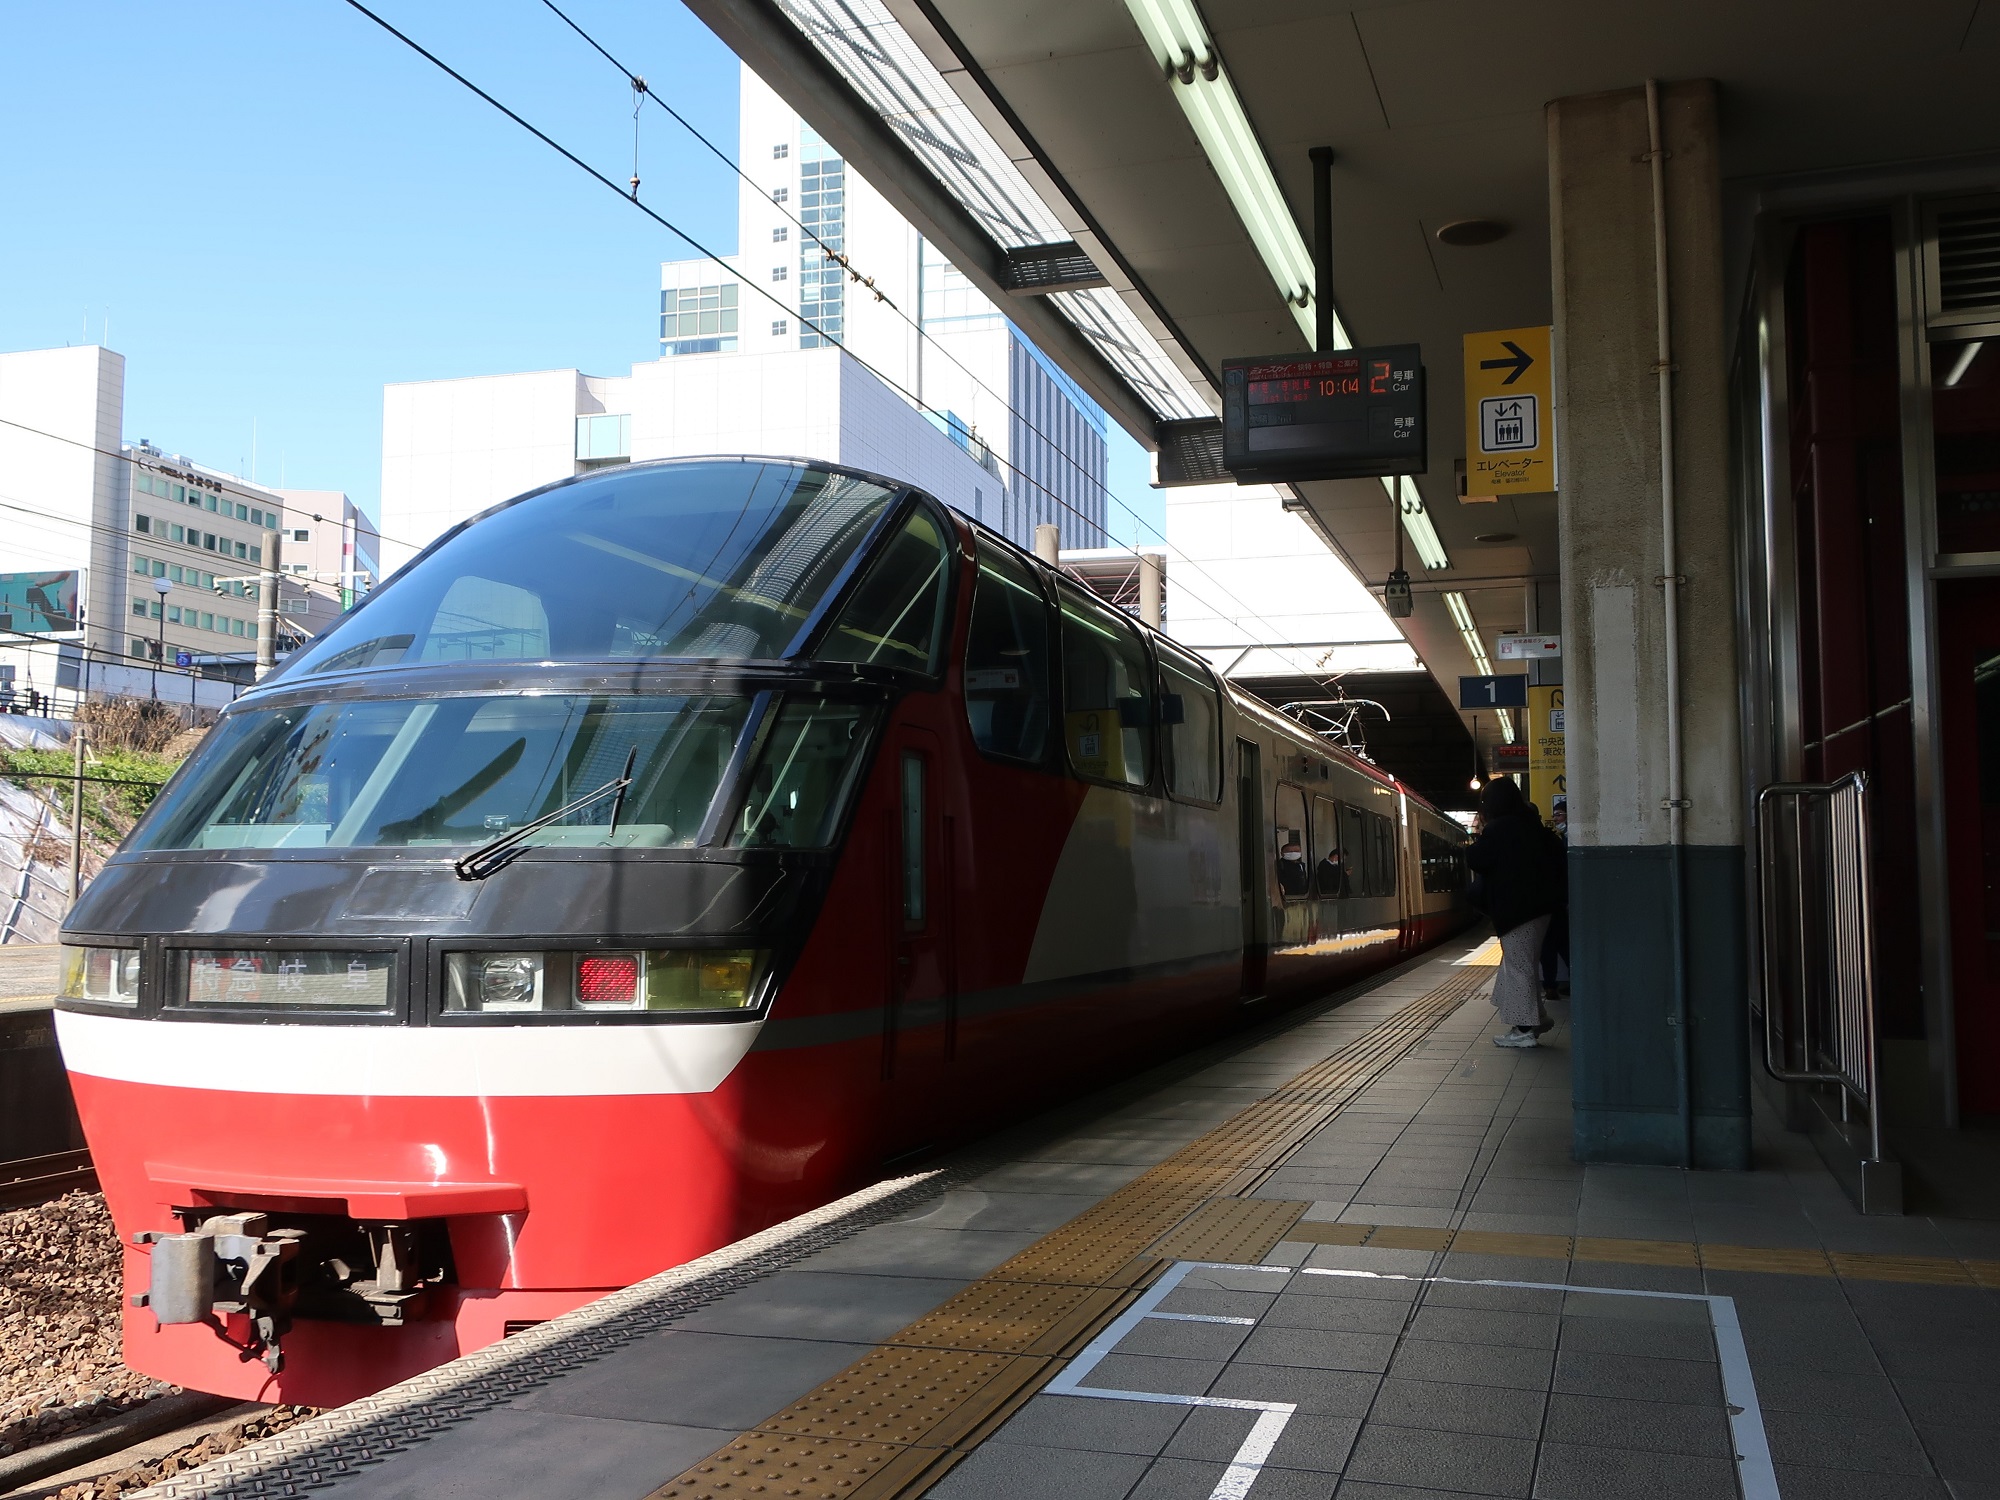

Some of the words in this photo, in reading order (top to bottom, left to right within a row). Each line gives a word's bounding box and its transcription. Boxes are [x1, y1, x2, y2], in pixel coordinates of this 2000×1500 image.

[1370, 362, 1390, 394] 2
[1393, 370, 1414, 381] 号車
[1392, 383, 1410, 392] Car
[1394, 417, 1415, 428] 号車
[1393, 430, 1411, 438] Car
[1476, 458, 1544, 471] エレベーター
[1494, 470, 1526, 478] Elevator
[1485, 681, 1496, 703] 1
[194, 958, 256, 993] 特急
